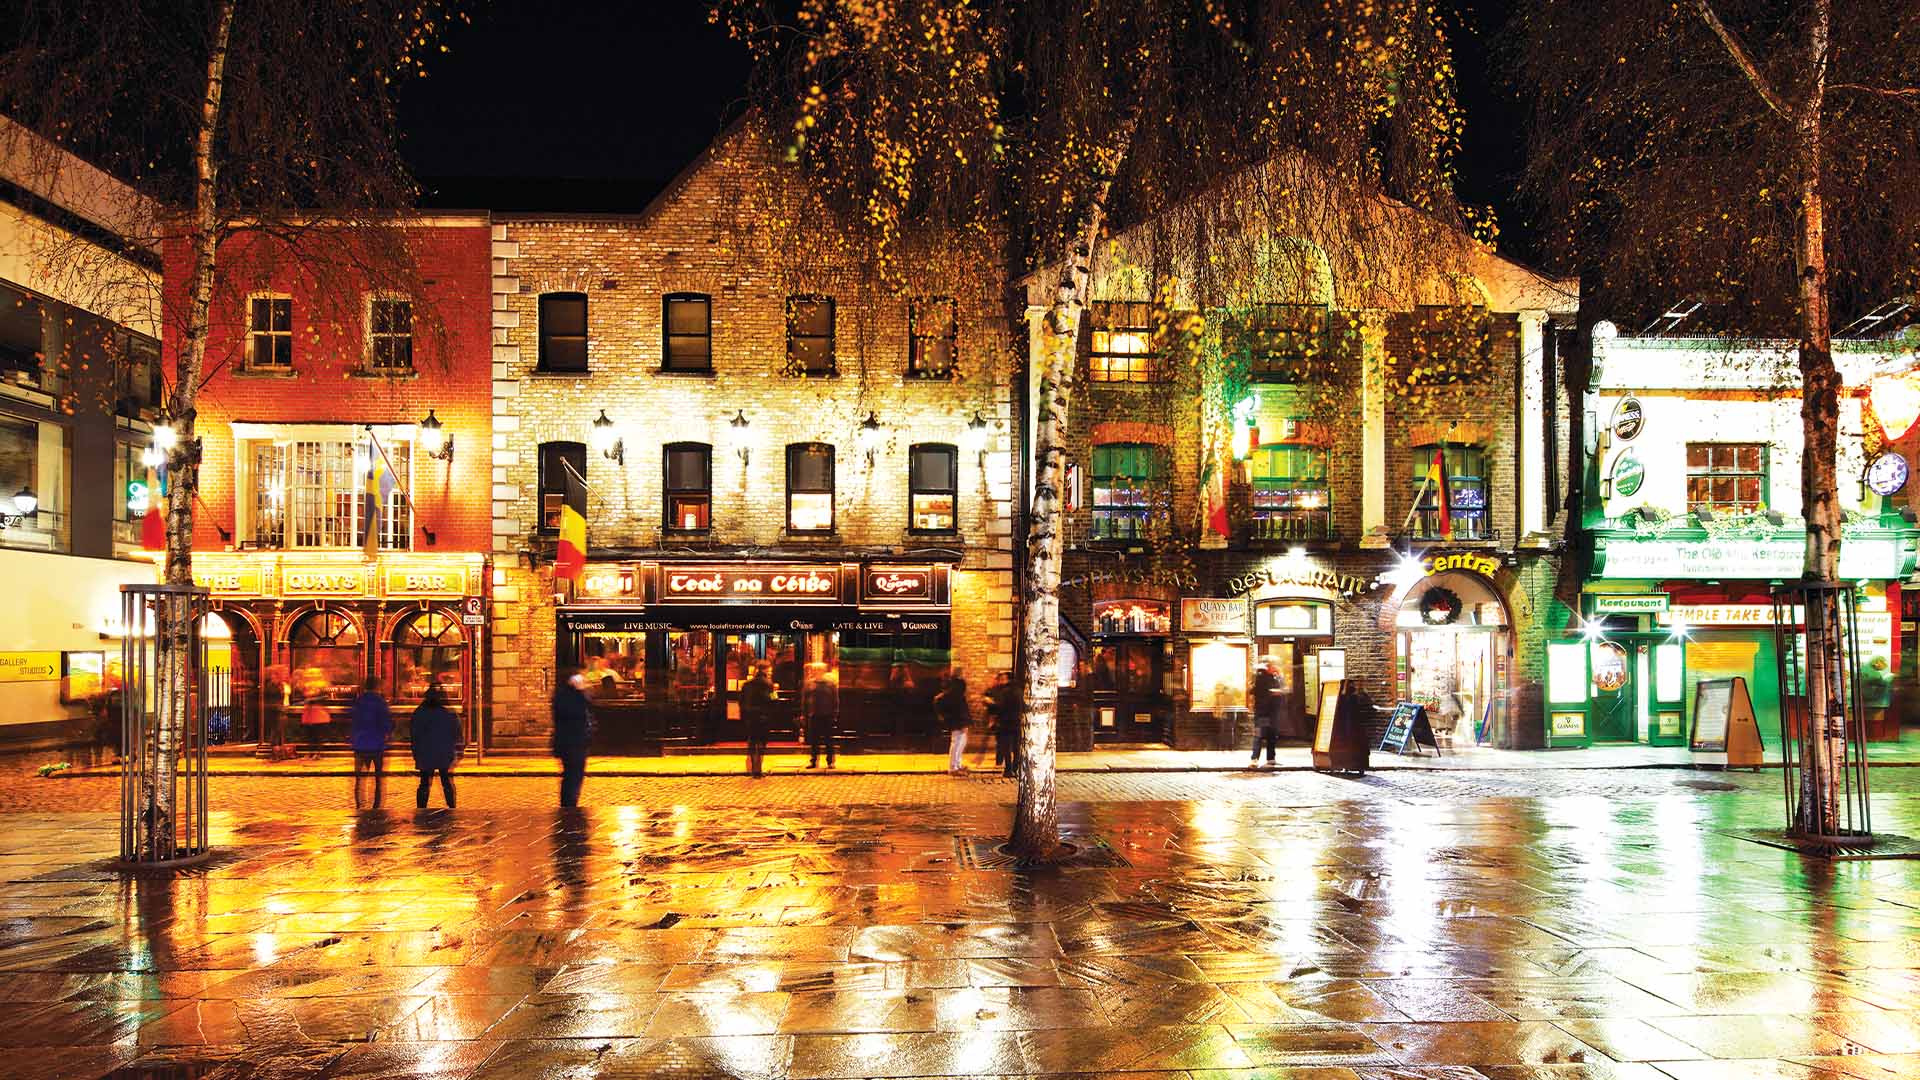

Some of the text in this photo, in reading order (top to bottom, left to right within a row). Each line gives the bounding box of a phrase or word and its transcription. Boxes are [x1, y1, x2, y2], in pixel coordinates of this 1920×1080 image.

[1423, 552, 1496, 577] Centra
[200, 574, 447, 591] THE QUAYS BAR
[733, 578, 763, 592] na
[1200, 601, 1226, 614] QUAYS
[1669, 609, 1719, 621] TEMPLE
[1726, 609, 1761, 621] TAKE
[575, 622, 606, 630] GUINNESS
[624, 622, 673, 630] LIVE MUSIC
[832, 622, 854, 630] LATE
[864, 622, 884, 630] LIVE
[908, 622, 939, 630] GUINNESS
[0, 657, 27, 666] GALLERY
